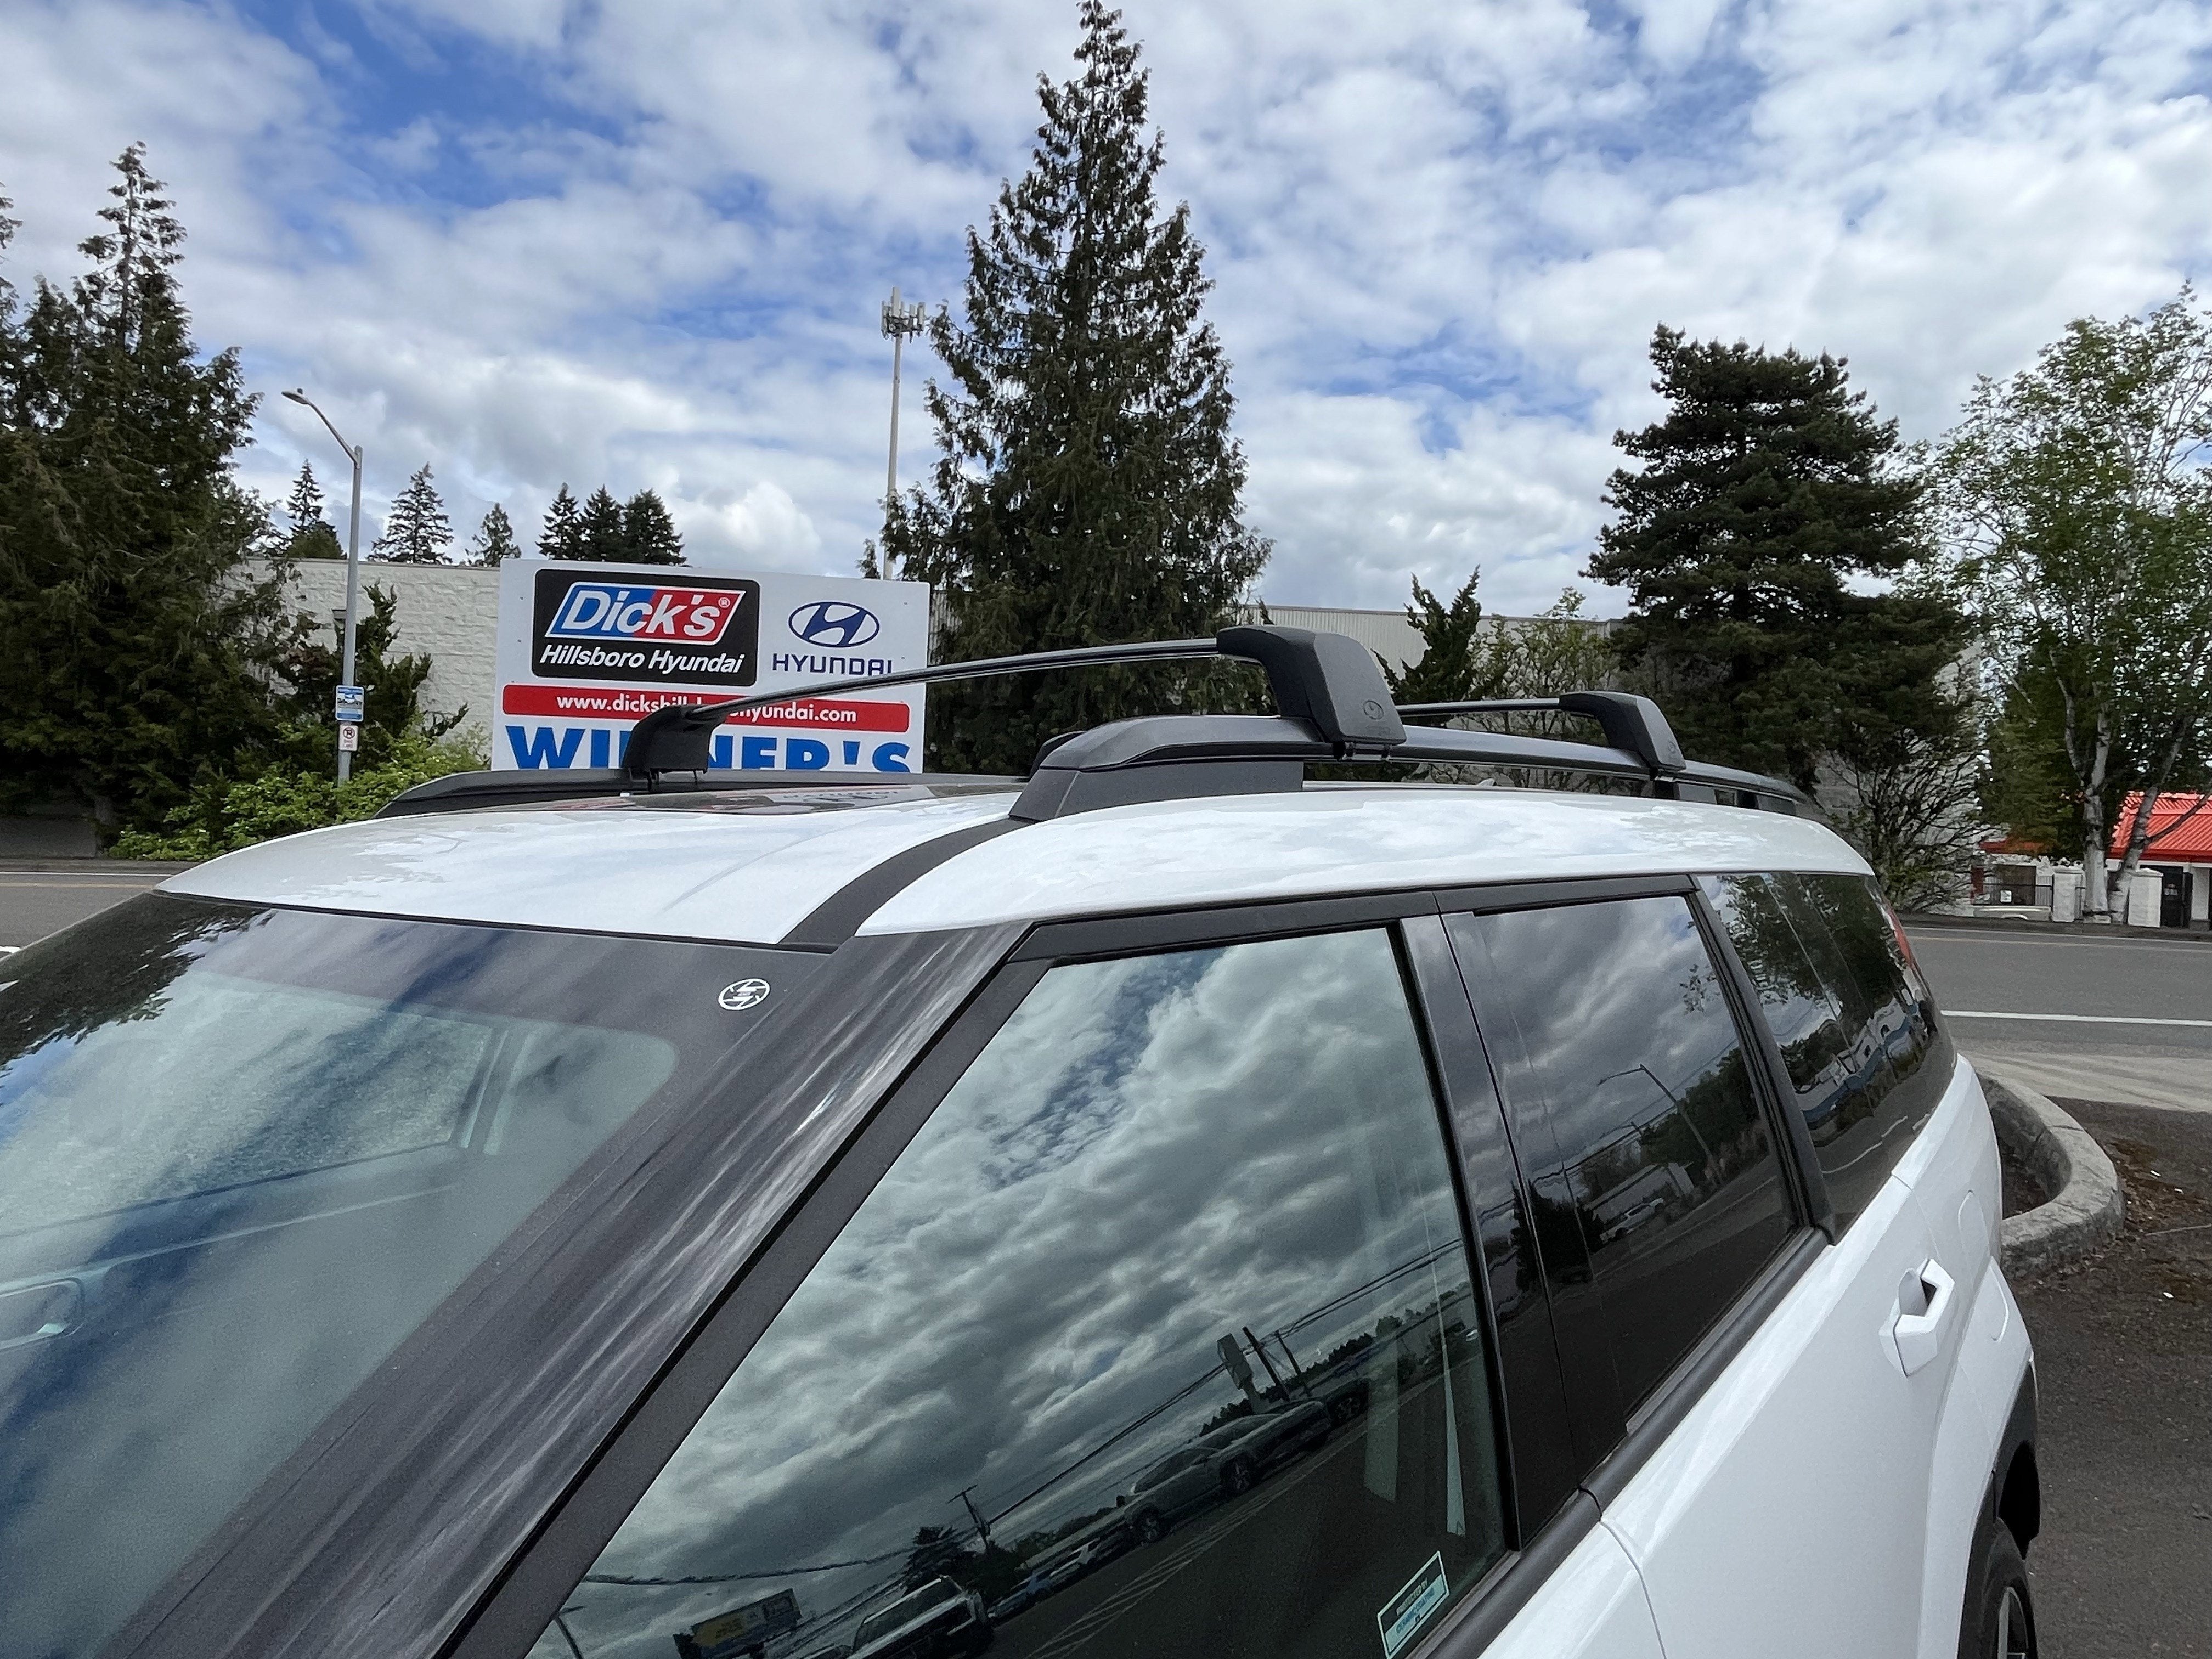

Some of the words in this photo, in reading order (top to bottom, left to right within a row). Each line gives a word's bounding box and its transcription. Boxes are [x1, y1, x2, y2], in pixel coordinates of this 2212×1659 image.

[561, 589, 720, 636] Dick's
[541, 644, 643, 669] Hillsboro
[647, 650, 745, 674] Hyundai
[772, 653, 892, 675] HYUNDAI
[506, 725, 910, 772] WIER'S
